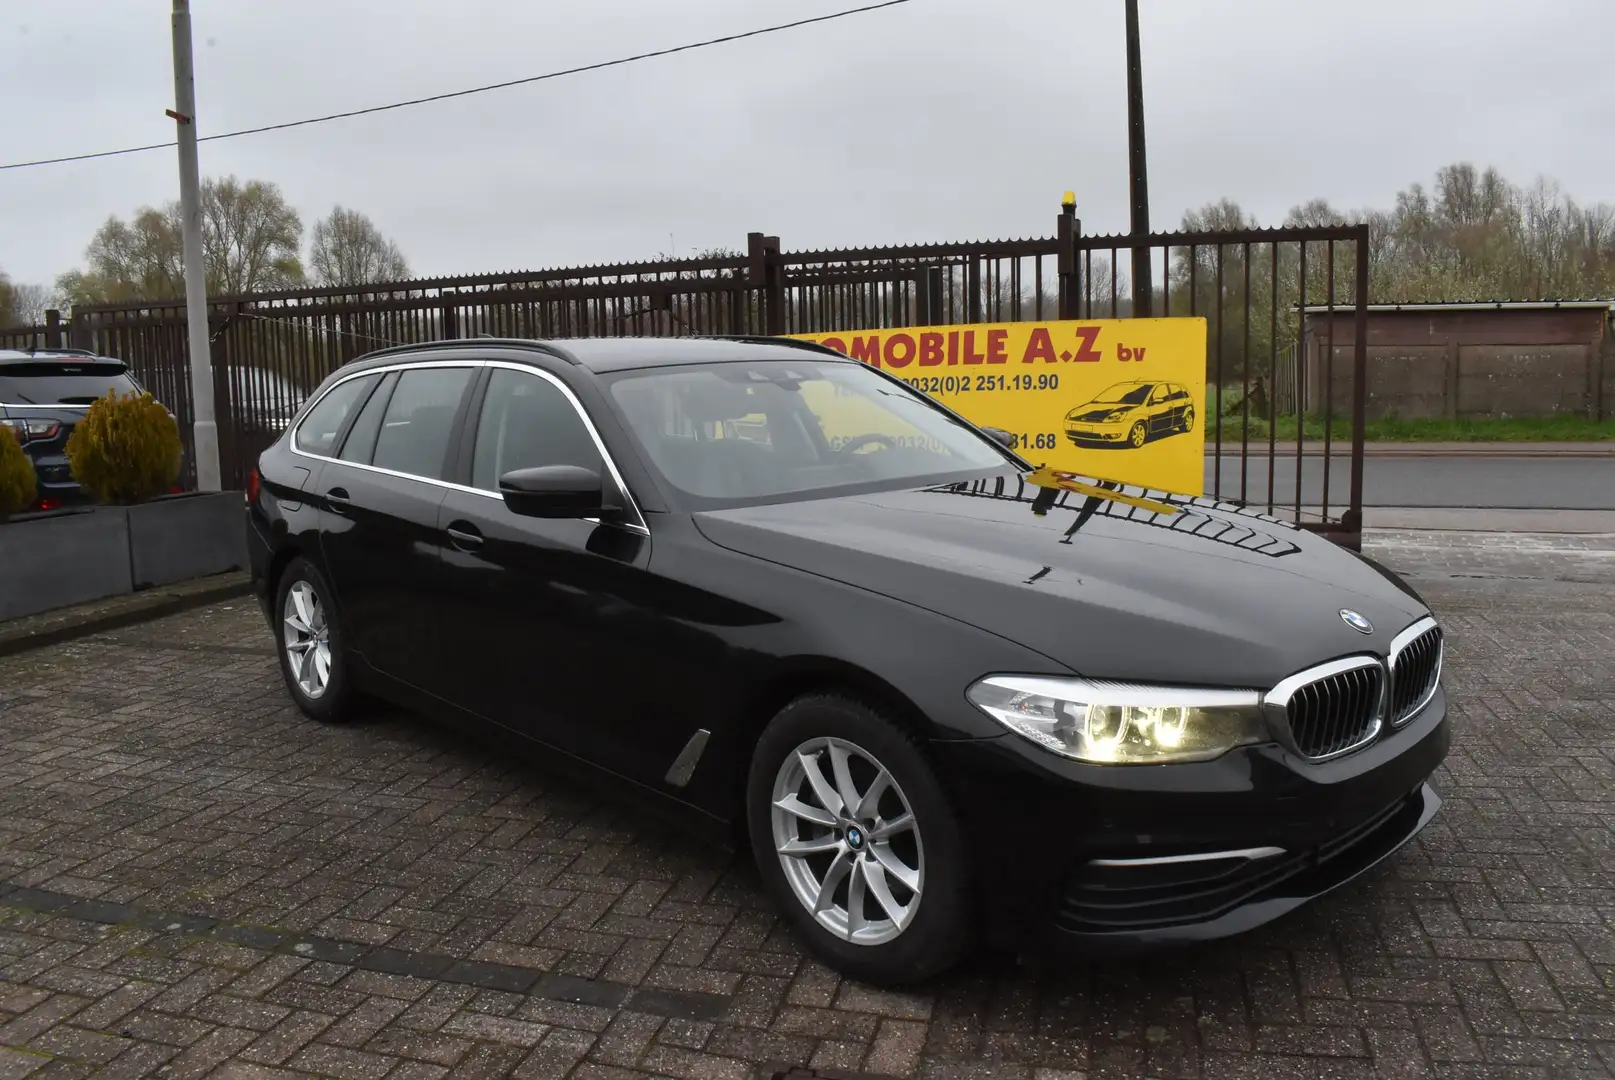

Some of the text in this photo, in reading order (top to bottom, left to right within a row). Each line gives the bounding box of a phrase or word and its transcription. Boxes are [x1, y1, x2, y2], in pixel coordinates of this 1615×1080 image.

[1021, 327, 1103, 363] A.Z
[1116, 343, 1146, 362] bv
[976, 374, 1059, 392] 251.19.90
